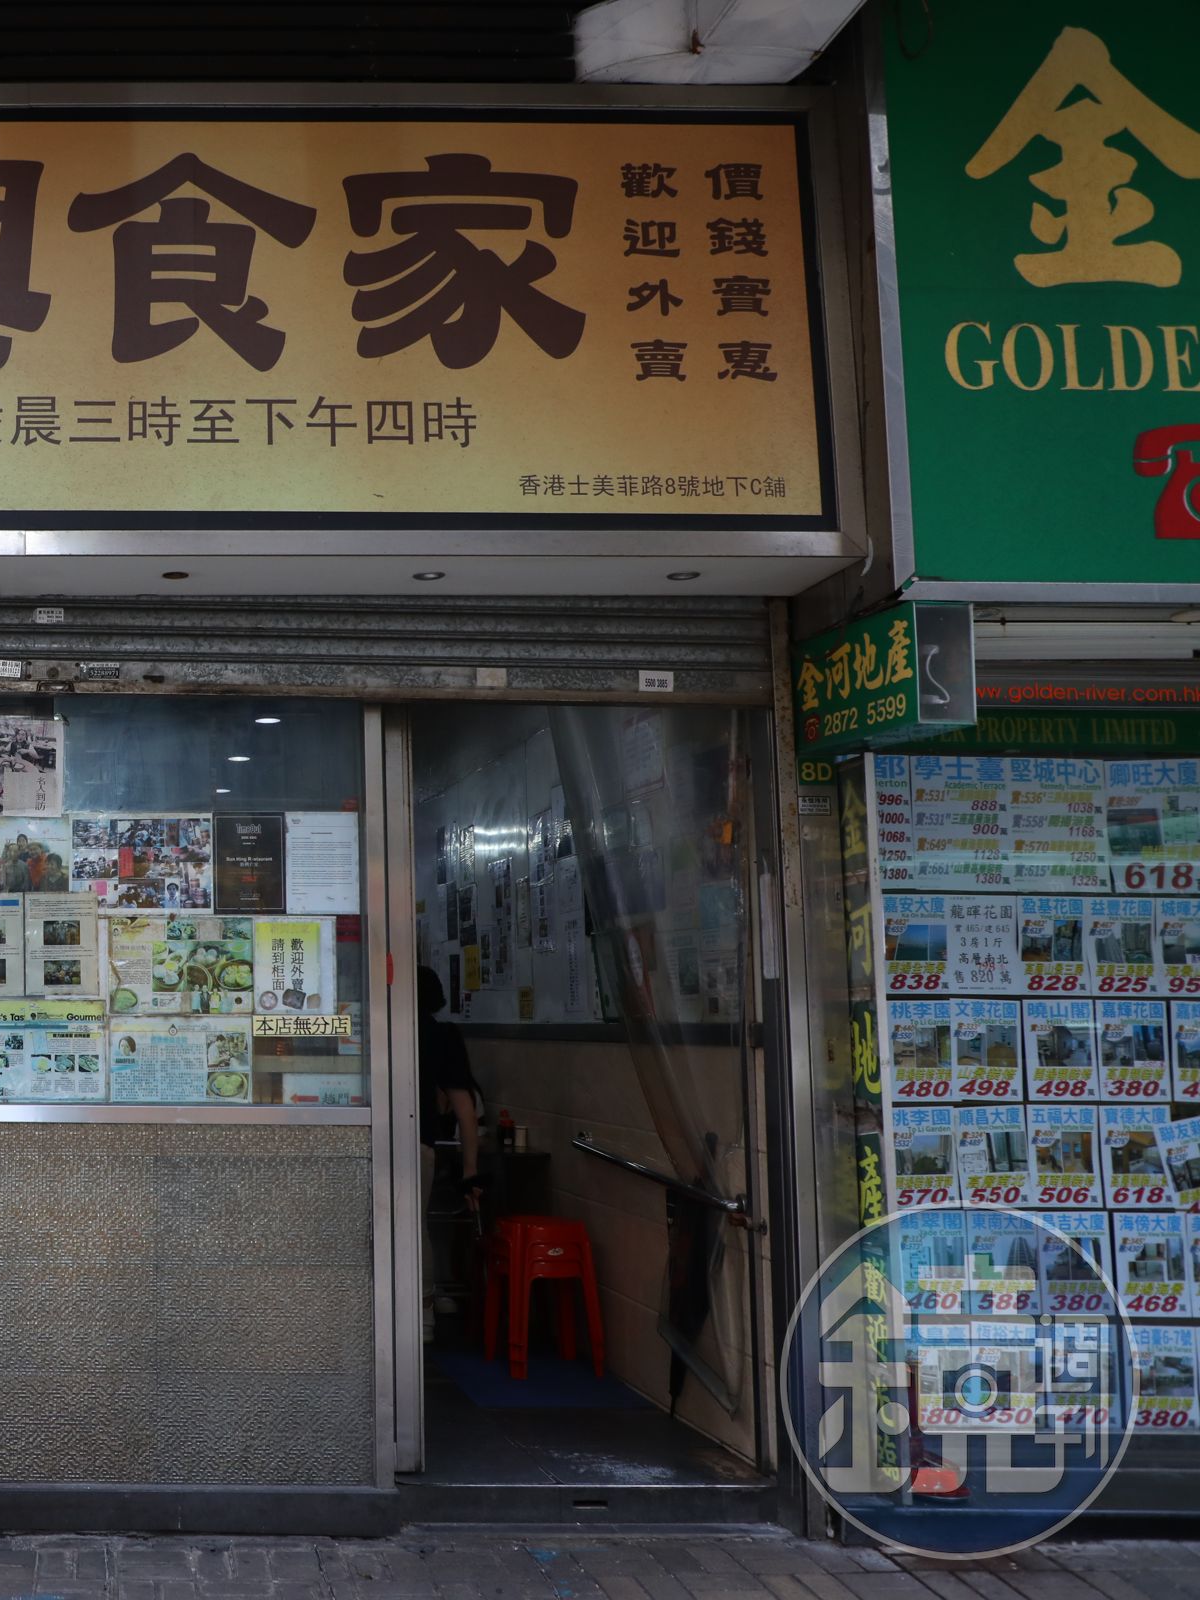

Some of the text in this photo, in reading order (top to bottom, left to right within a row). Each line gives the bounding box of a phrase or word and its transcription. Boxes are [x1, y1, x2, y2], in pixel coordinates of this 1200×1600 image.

[965, 26, 1200, 288] 金
[620, 163, 688, 383] 歡迎外賣
[706, 163, 777, 383] 價錢實惠
[519, 474, 786, 498] 香港士美菲路8號地下C舖
[797, 620, 913, 712] 金河地產
[824, 694, 907, 737] 2872 5599
[976, 717, 1177, 745] PROPERTY LIMITED
[801, 761, 833, 782] 8D
[915, 756, 1005, 781] 學士臺
[1011, 758, 1100, 784] 堅城中心
[875, 780, 908, 788] erton
[971, 800, 998, 811] 888
[973, 824, 999, 835] 900
[1125, 863, 1195, 890] 618
[890, 974, 941, 990] 838
[1028, 975, 1079, 991] 828
[1098, 976, 1149, 992] 825
[256, 1016, 349, 1035] 本店無分店
[898, 1080, 950, 1097] 480
[959, 1079, 1011, 1097] 498
[1036, 1080, 1088, 1097] 498
[1108, 1080, 1160, 1096] 380
[1032, 1107, 1094, 1124] 五福大廈
[897, 1188, 949, 1206] 570
[970, 1186, 1021, 1204] 550
[1038, 1186, 1091, 1204] 506
[1113, 1186, 1165, 1204] 618
[906, 1292, 958, 1310] 460
[978, 1293, 1031, 1311] 588
[1050, 1294, 1103, 1311] 380
[1127, 1295, 1178, 1312] 468
[1134, 1409, 1189, 1427] 380
